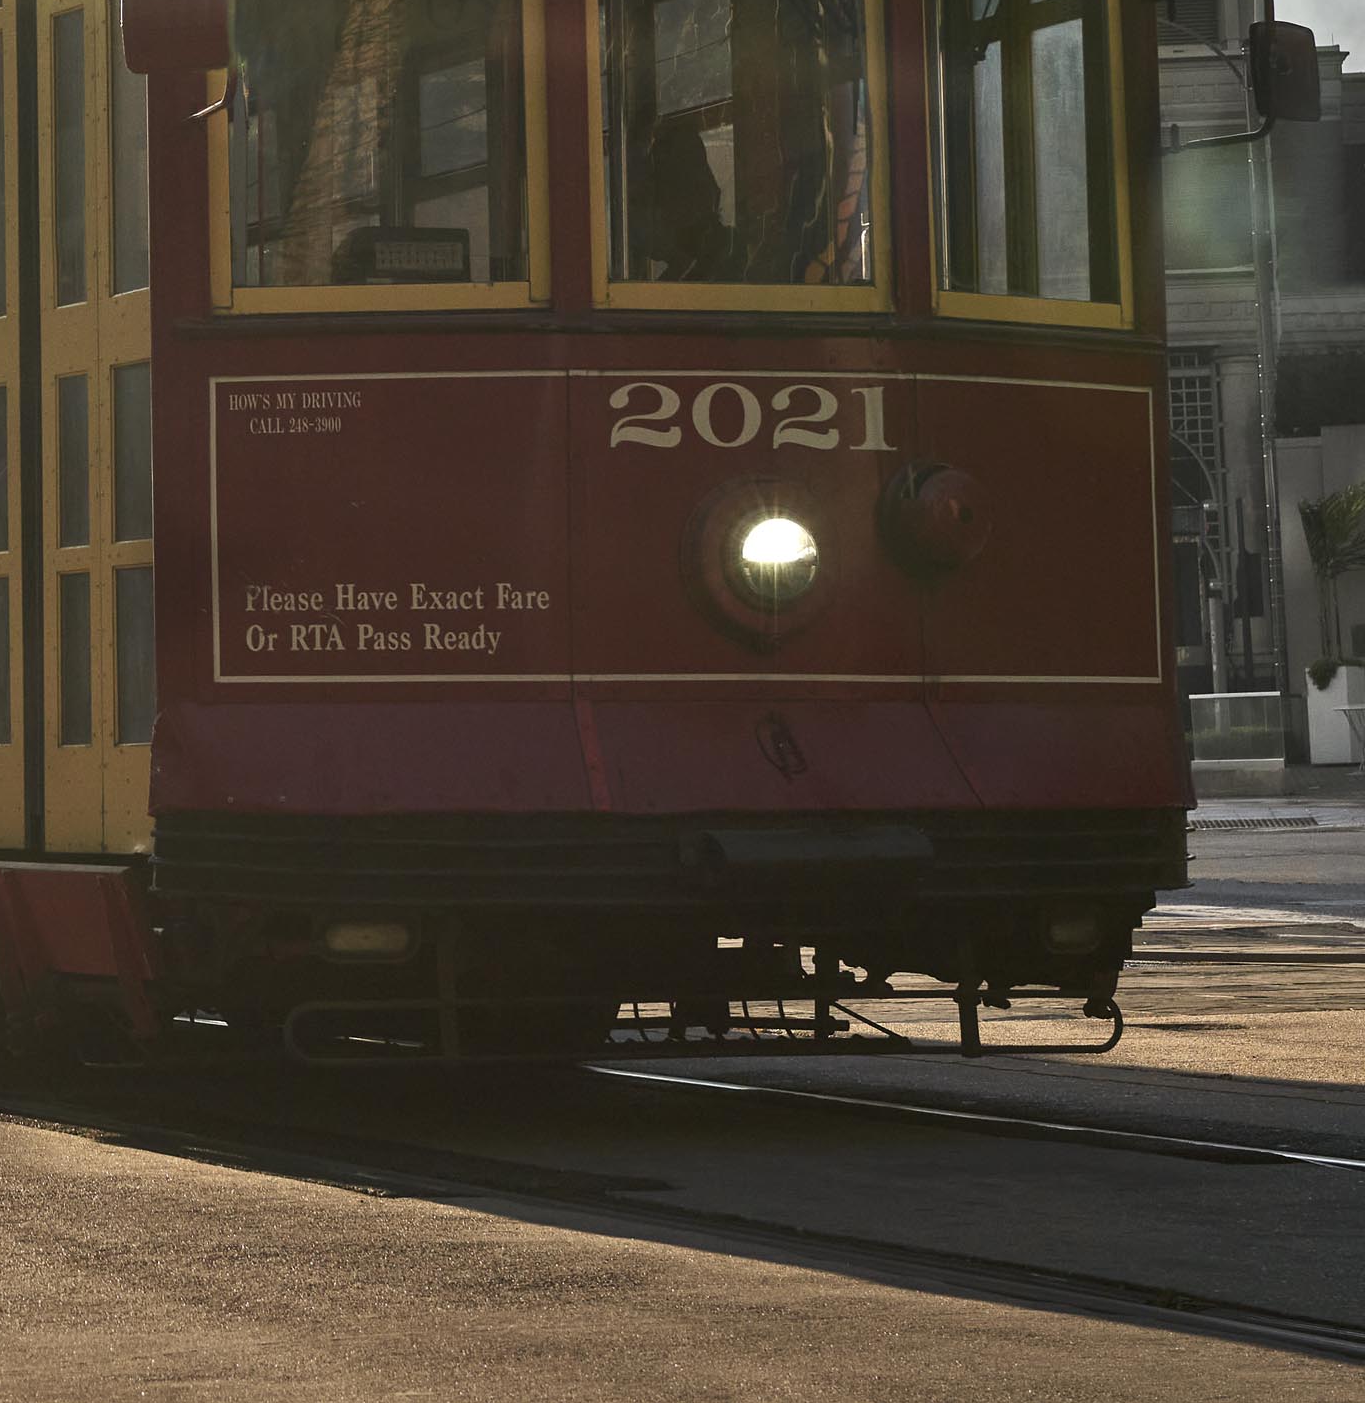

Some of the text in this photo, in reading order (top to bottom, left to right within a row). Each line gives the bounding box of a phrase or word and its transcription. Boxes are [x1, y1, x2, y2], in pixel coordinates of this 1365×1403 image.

[229, 390, 362, 411] HOW'S MY DRIVING
[250, 416, 342, 434] CALL 248-3900
[609, 382, 898, 451] 2021
[245, 582, 550, 611] Please Have Exact Fare
[245, 622, 502, 654] Or RTA Pass Ready
